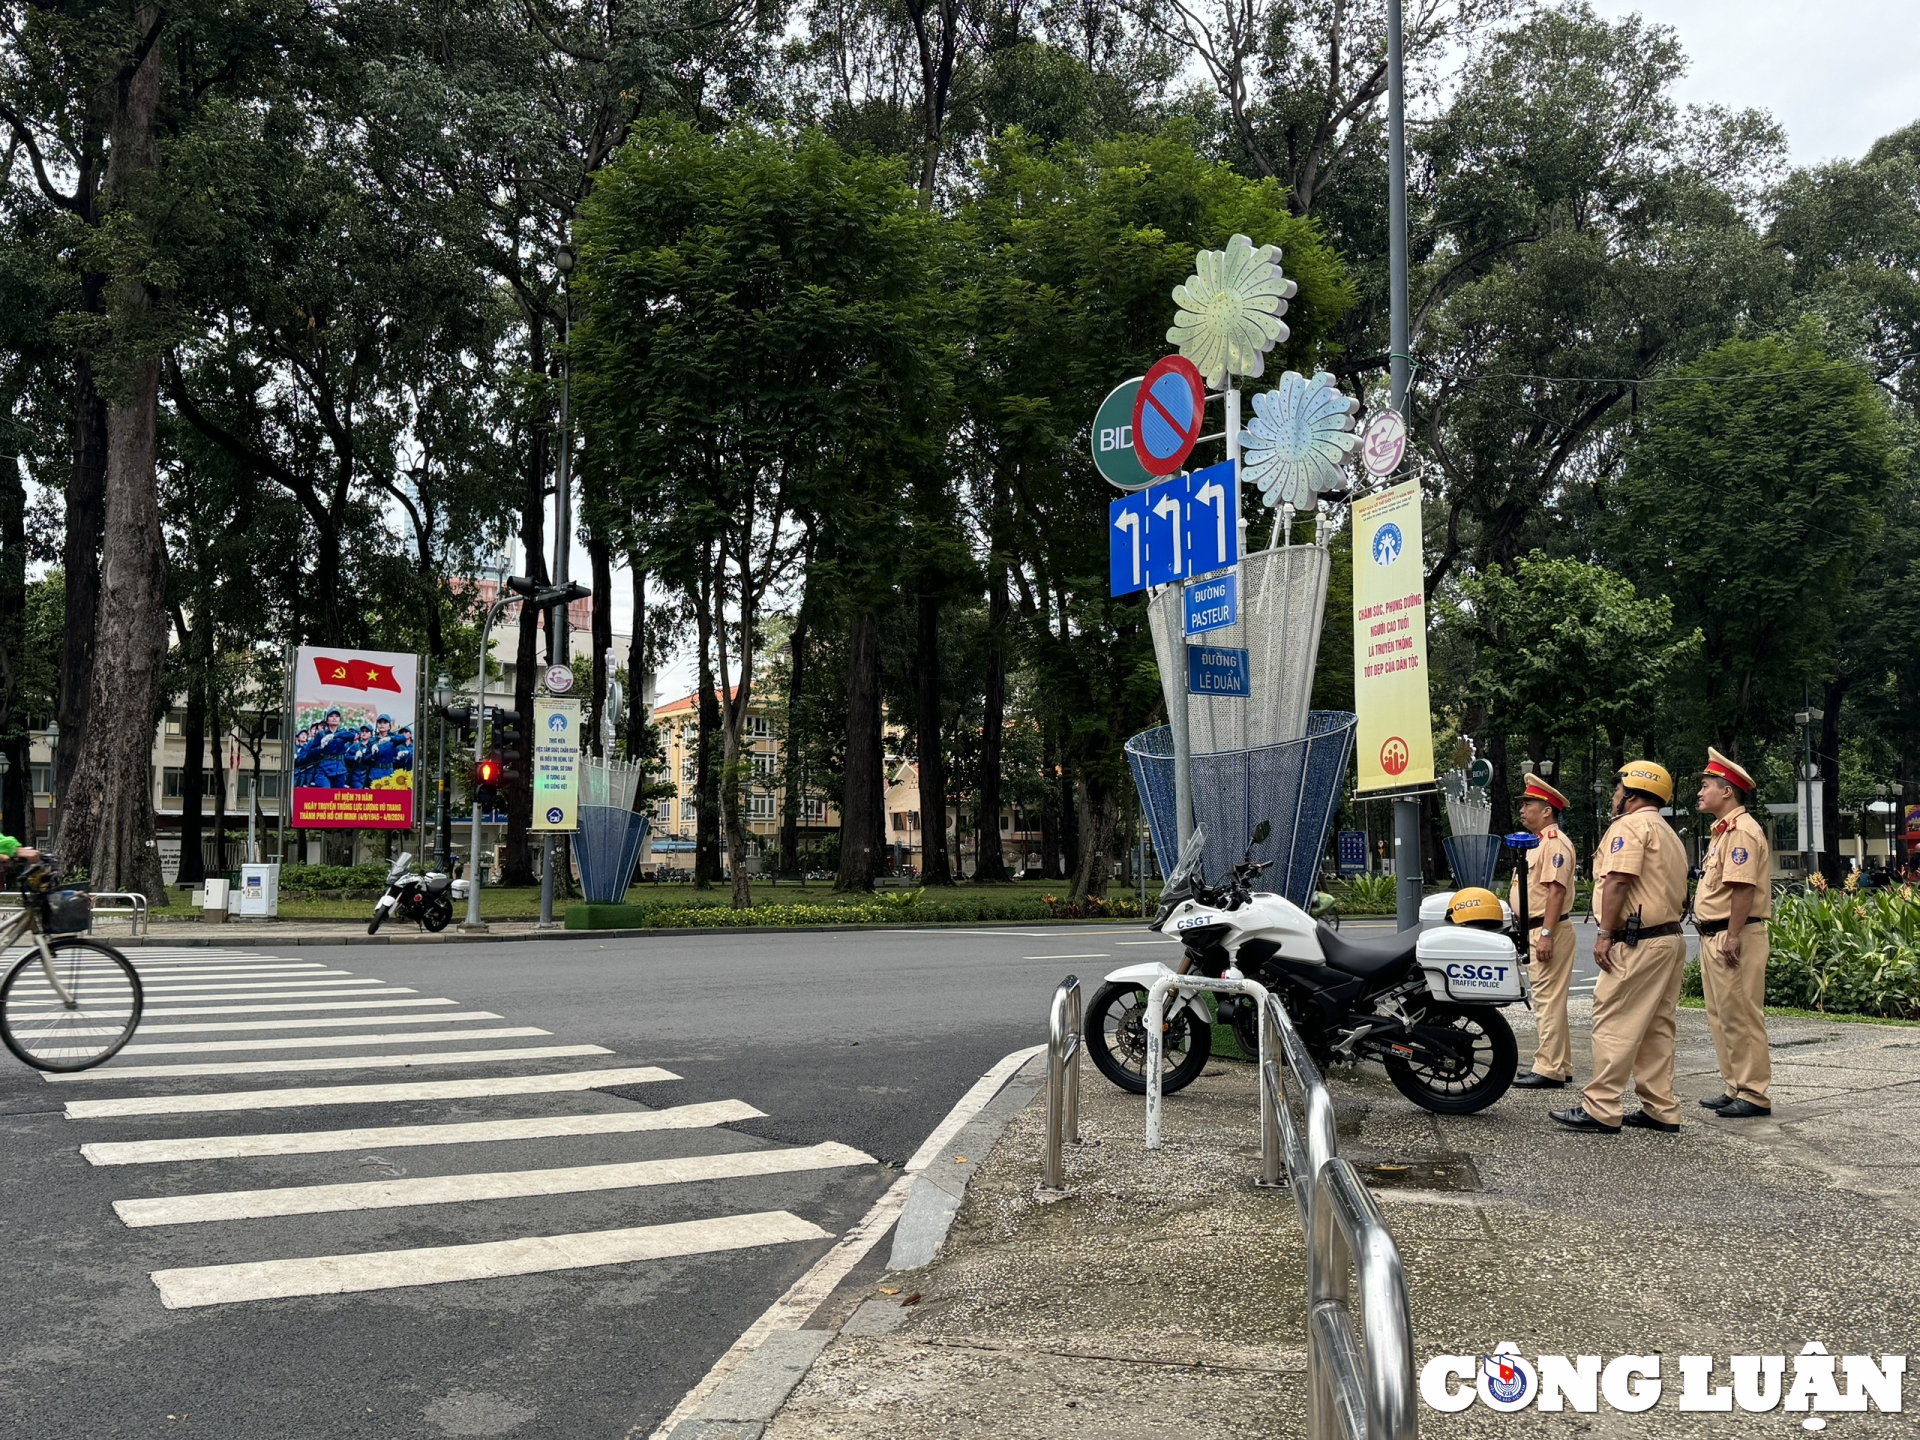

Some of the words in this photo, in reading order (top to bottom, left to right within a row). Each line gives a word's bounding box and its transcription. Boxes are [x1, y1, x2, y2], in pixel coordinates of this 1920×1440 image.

[1101, 426, 1134, 452] BID
[1195, 585, 1225, 603] ĐƯỜNG
[1192, 605, 1229, 628] PASTEUR
[1358, 606, 1372, 621] CHĂM
[1386, 599, 1402, 614] PHỤNG
[1404, 593, 1421, 609] DƯỠNG
[1370, 621, 1385, 637] NGƯỜI
[1387, 621, 1396, 633] CAO
[1398, 613, 1409, 630] TUỔI
[1368, 644, 1374, 657] LÀ
[1375, 638, 1394, 655] TRUYỀN
[1395, 634, 1412, 651] THỐNG
[1202, 653, 1236, 667] ĐƯỜNG
[1364, 662, 1373, 678] TỐT
[1374, 663, 1384, 677] ĐẸP
[1385, 658, 1395, 673] CỦA
[1396, 657, 1407, 671] DÂN
[1408, 654, 1418, 670] TỘC
[1200, 672, 1211, 689] LÊ
[1214, 670, 1240, 690] DUẨN
[1631, 770, 1660, 781] CSGT
[1454, 899, 1480, 911] CSGT
[1177, 915, 1213, 929] CSGT
[1447, 964, 1508, 981] C.S.G.T
